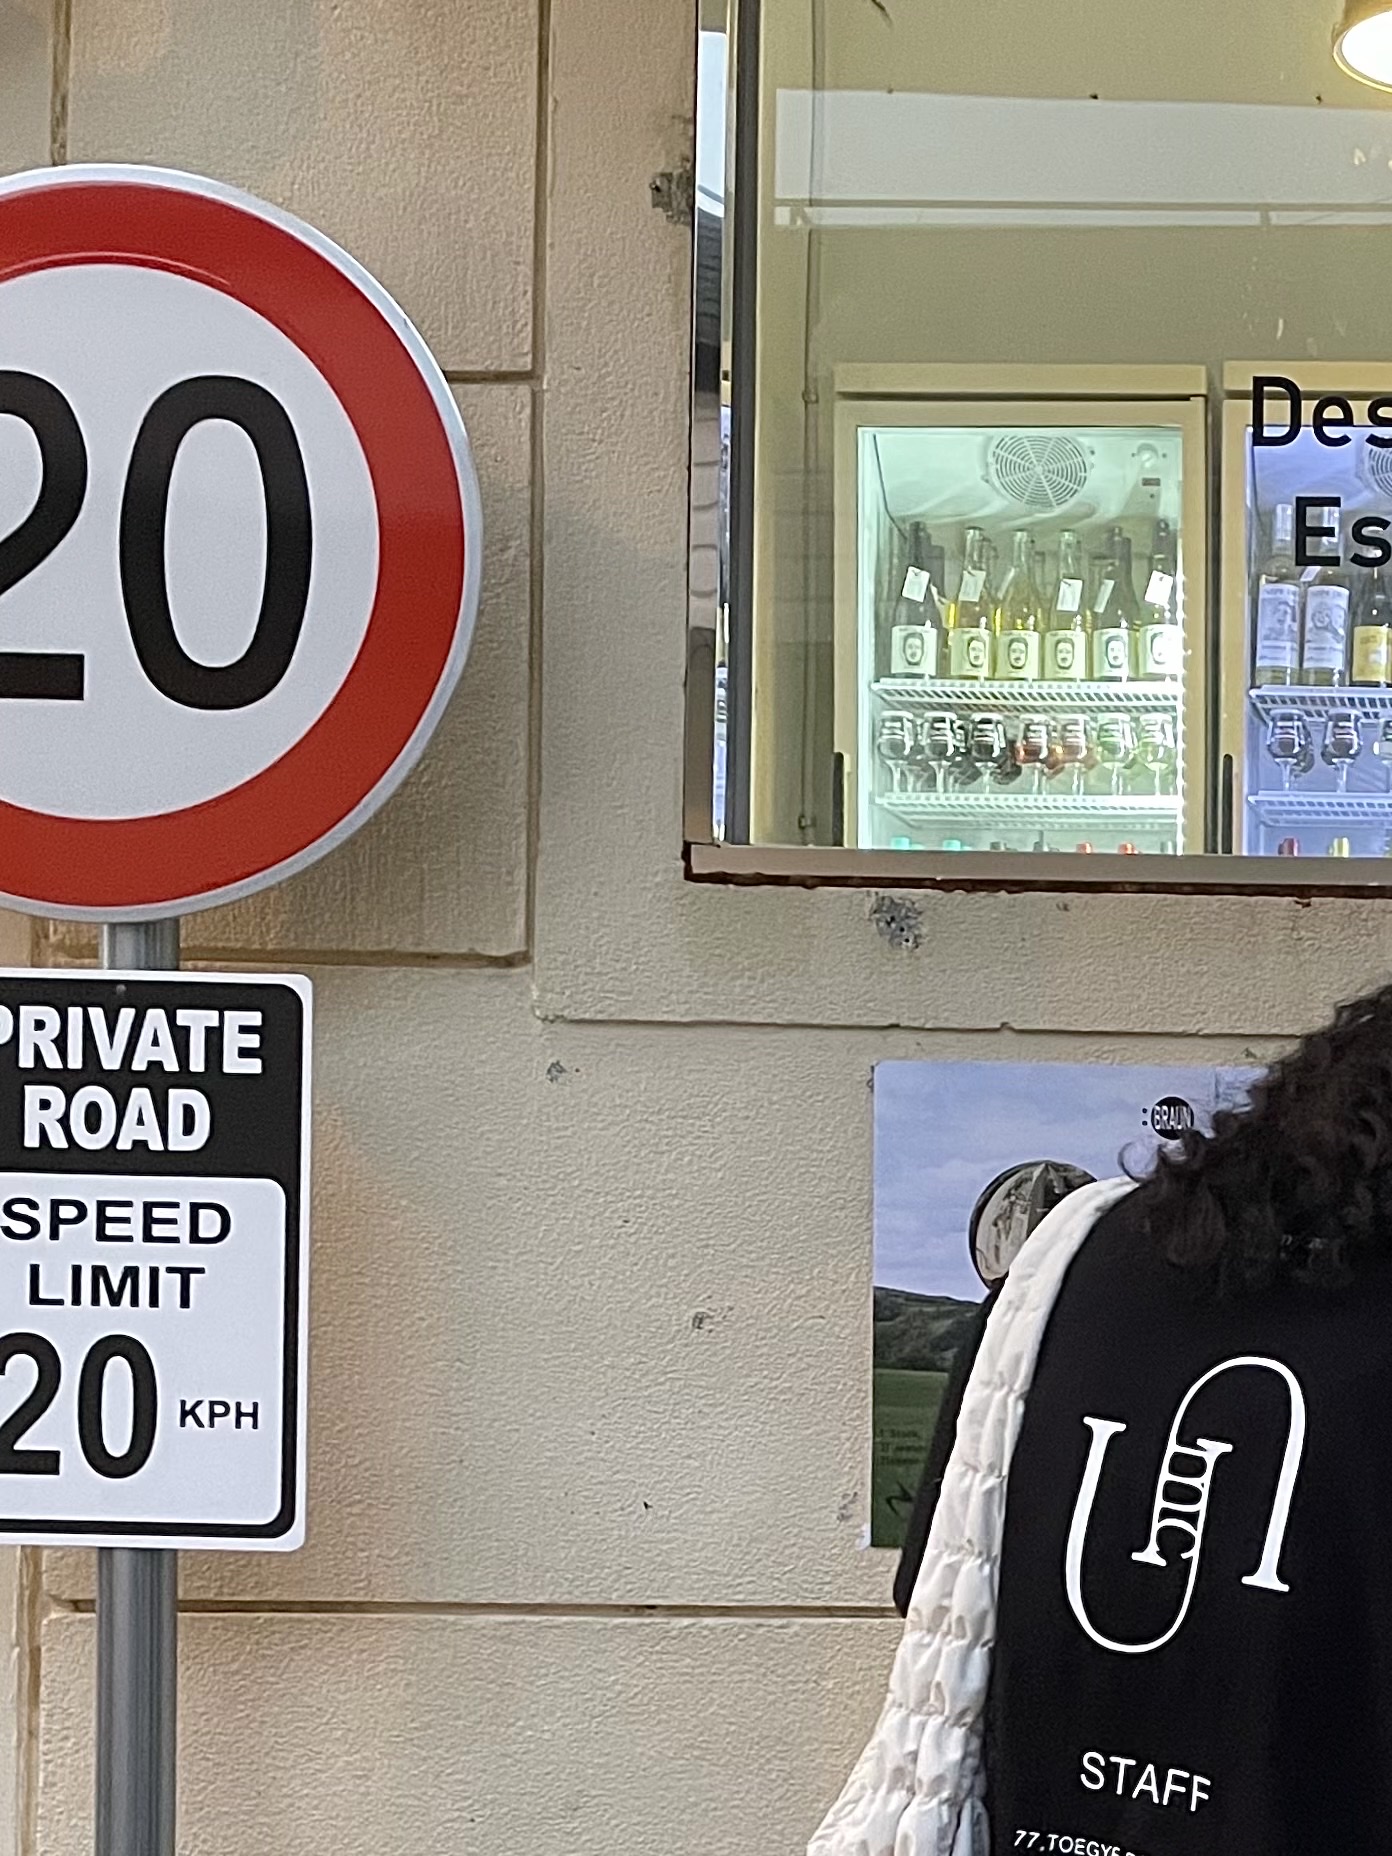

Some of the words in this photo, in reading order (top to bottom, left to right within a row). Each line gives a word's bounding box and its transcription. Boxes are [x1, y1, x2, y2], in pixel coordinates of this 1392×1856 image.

[0, 370, 313, 711] 20
[0, 1004, 264, 1075] RIVATE
[22, 1084, 212, 1153] ROAD
[0, 1197, 233, 1245] SPEED
[28, 1263, 206, 1309] LIMIT
[0, 1331, 158, 1479] 20
[179, 1398, 259, 1430] KPH
[1080, 1751, 1212, 1812] STAFF
